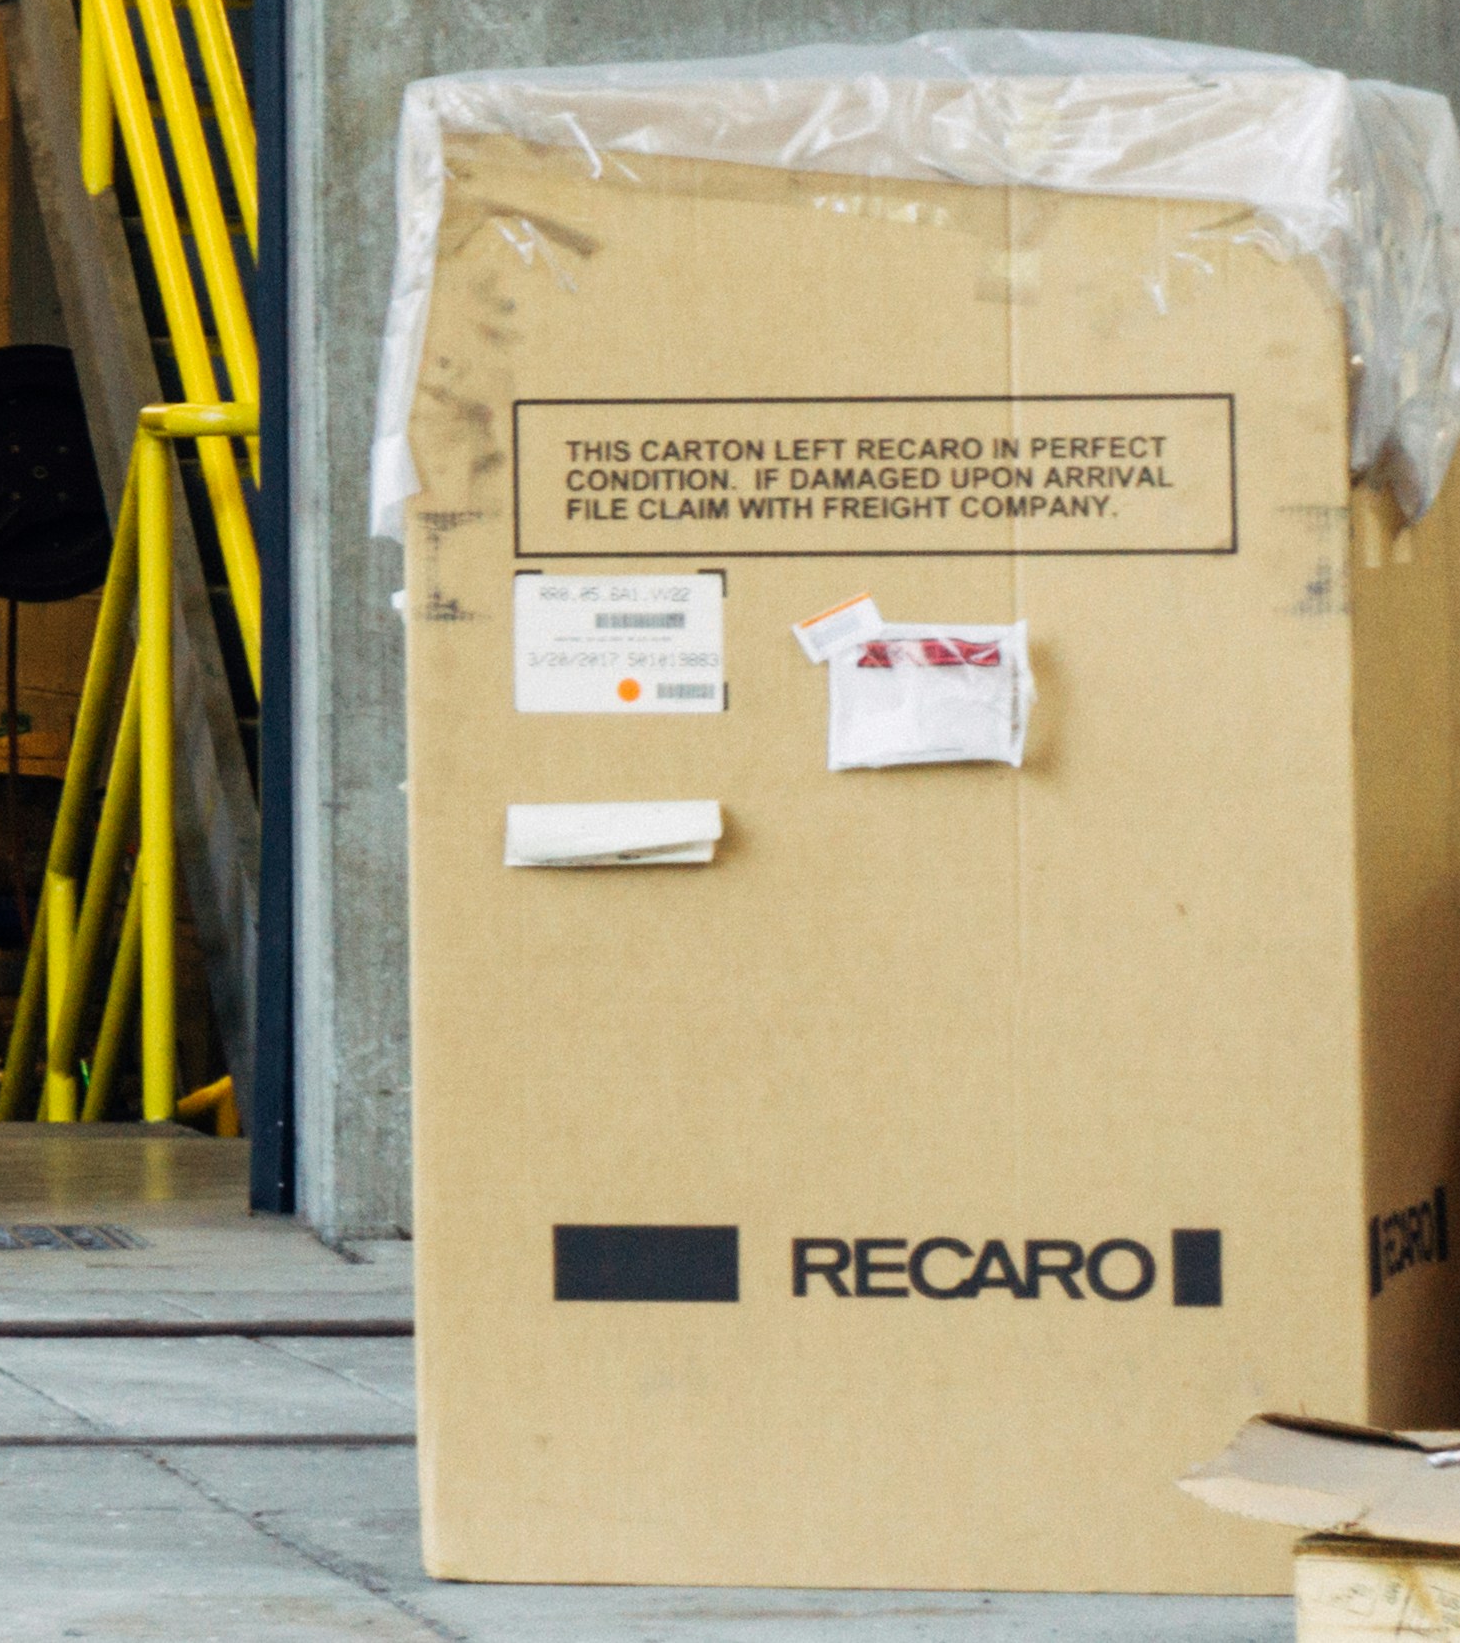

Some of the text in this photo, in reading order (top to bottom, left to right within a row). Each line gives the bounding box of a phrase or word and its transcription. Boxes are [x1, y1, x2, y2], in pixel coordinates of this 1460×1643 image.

[565, 435, 1167, 463] THIS CARTON LEFT RECARO IN PERFECT
[565, 465, 1173, 493] CONDITION. IF DAMAGED UPON ARRIVAL
[565, 495, 1119, 521] FILE CLAIM WITH FREIGHT COMPANY.
[790, 1234, 1159, 1304] RECARO
